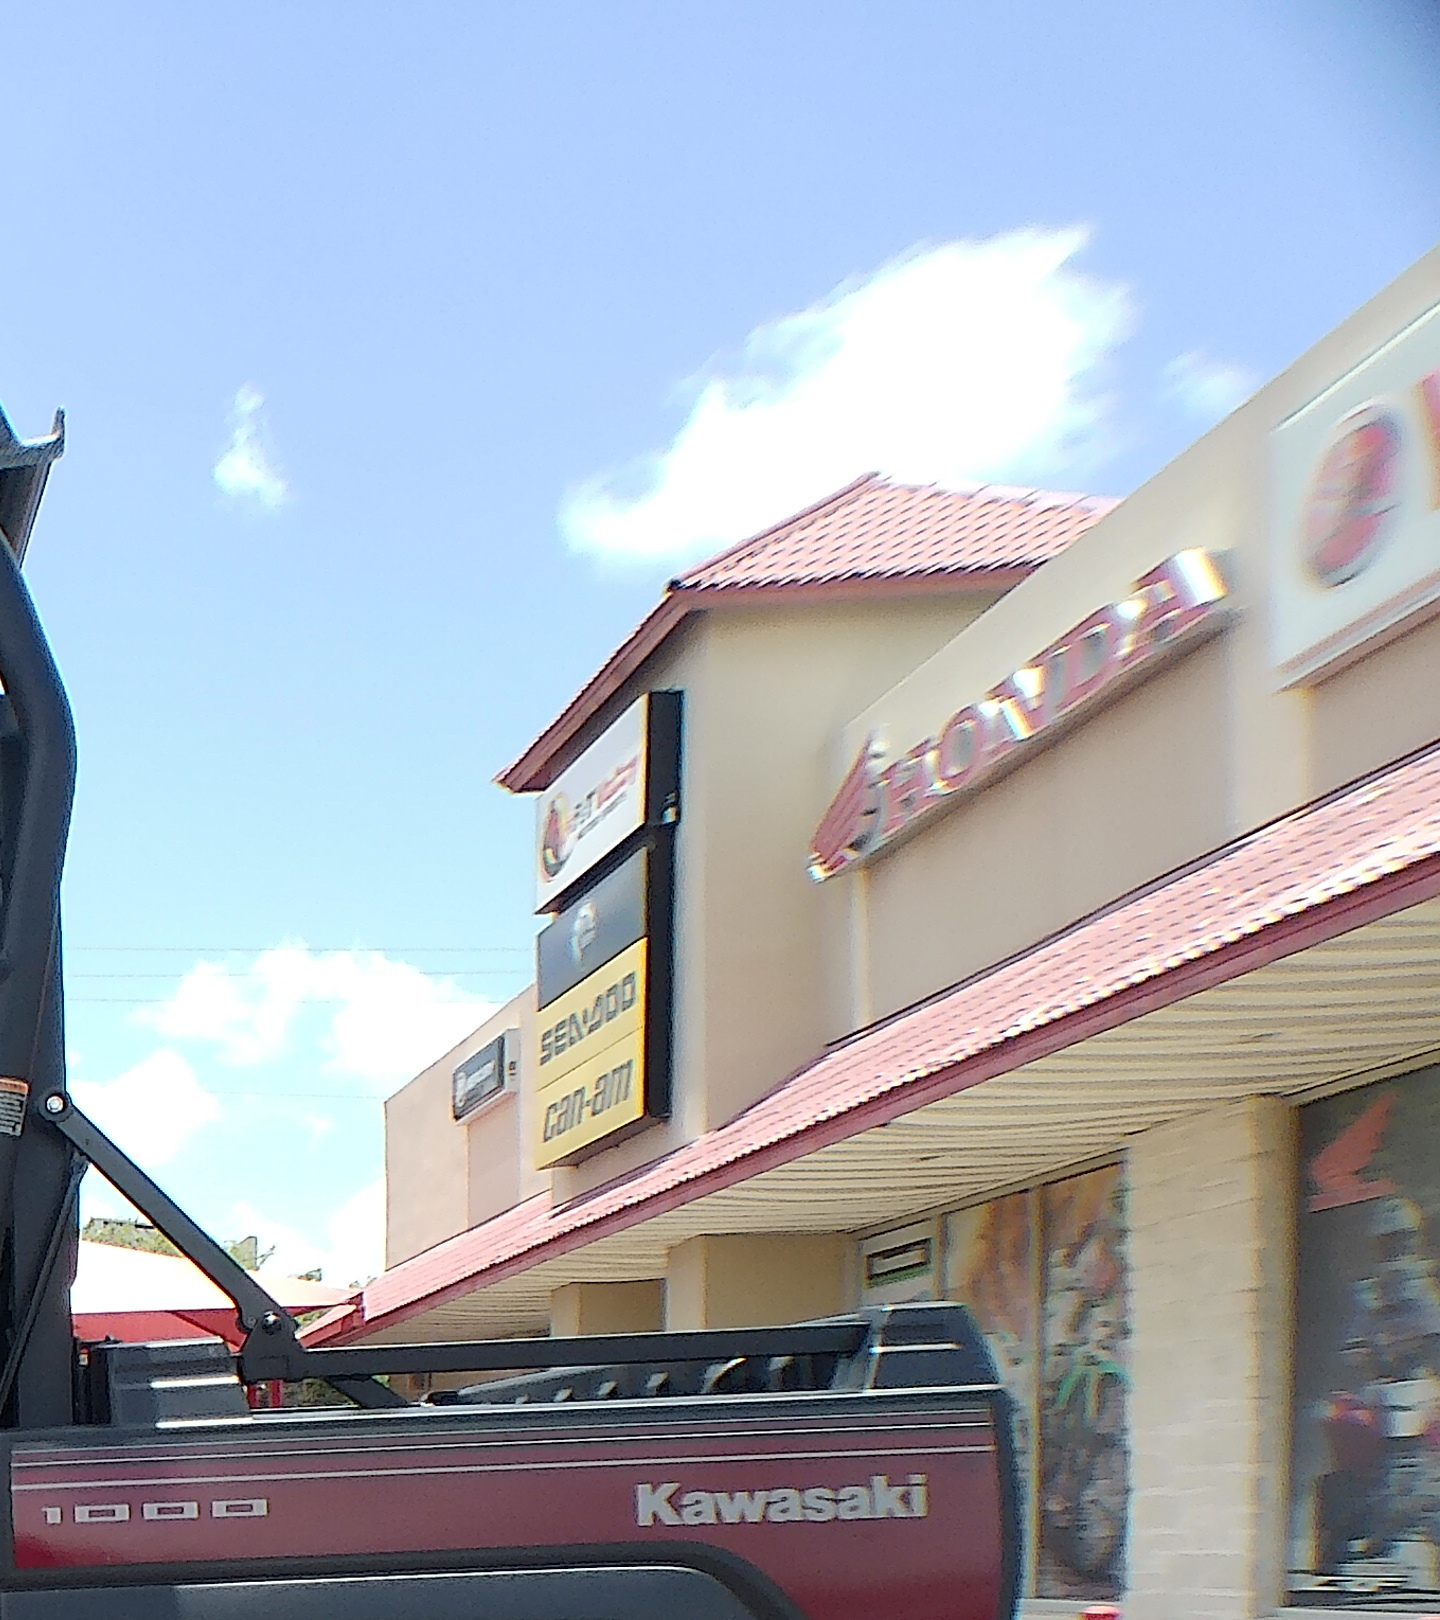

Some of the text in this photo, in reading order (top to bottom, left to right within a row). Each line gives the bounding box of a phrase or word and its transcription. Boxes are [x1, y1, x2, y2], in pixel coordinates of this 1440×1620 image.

[878, 547, 1228, 838] HONDA
[40, 1498, 269, 1525] 1000
[636, 1473, 929, 1527] Kawasaki
